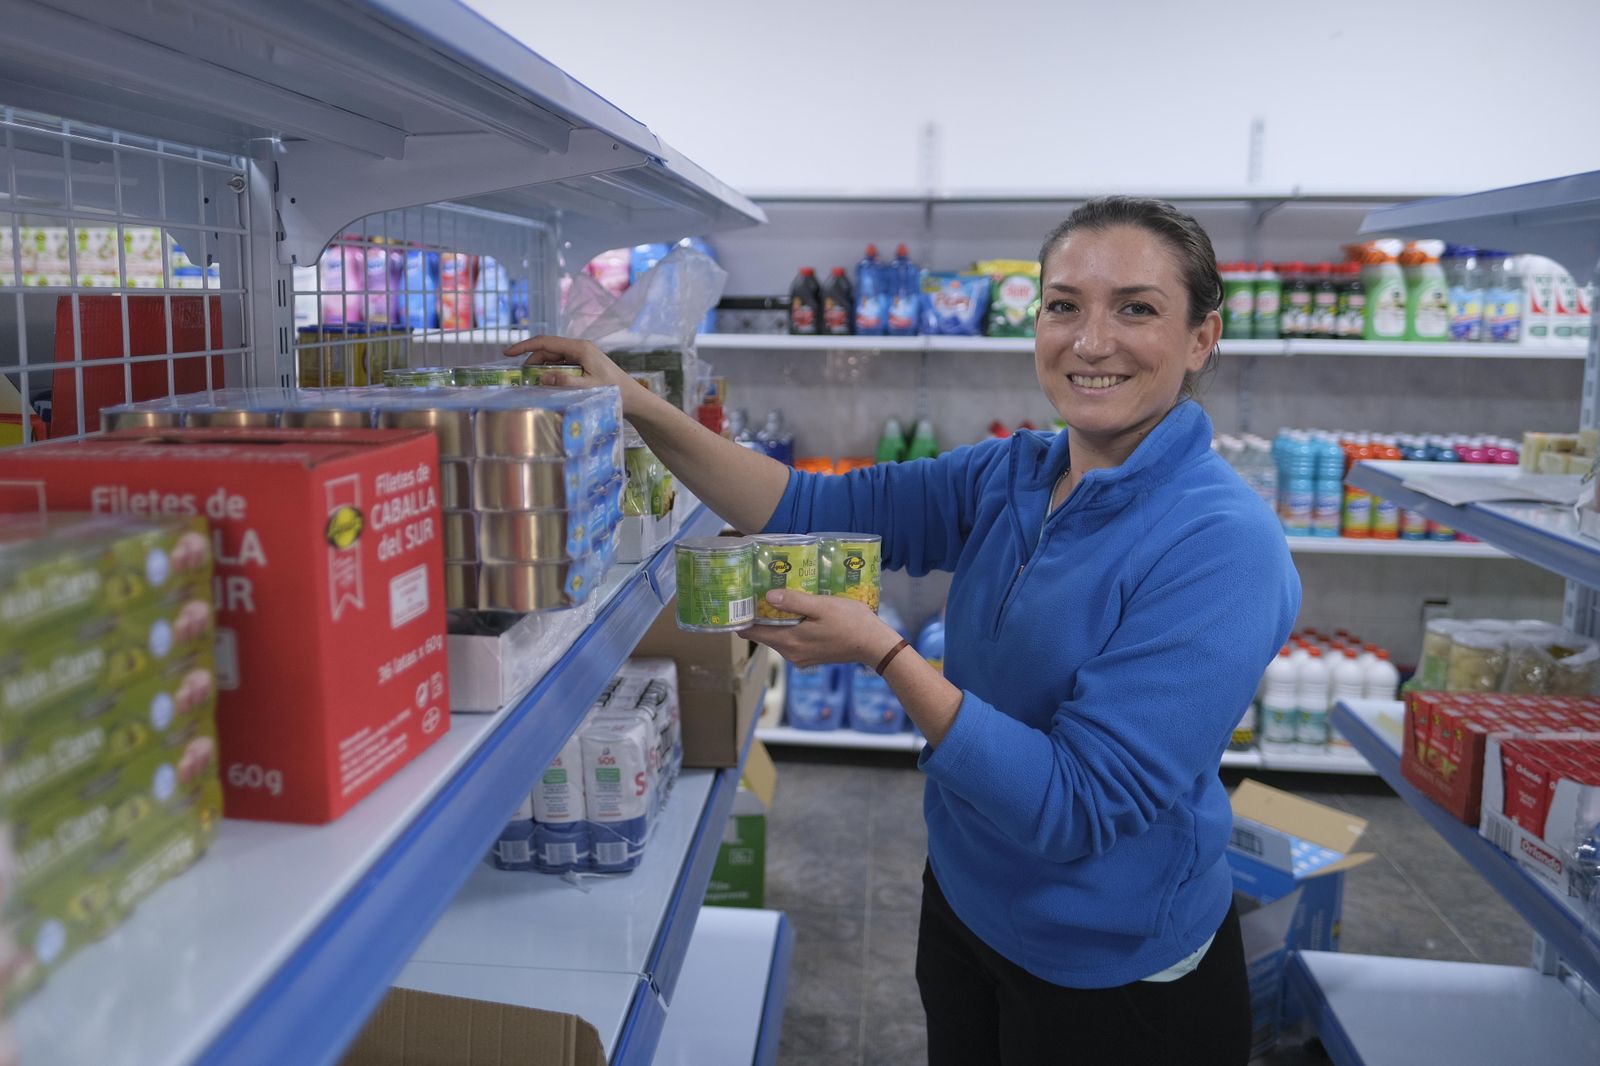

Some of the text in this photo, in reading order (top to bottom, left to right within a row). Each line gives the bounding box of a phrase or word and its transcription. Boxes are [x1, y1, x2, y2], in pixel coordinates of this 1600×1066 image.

[376, 462, 430, 496] Filetes de
[91, 483, 247, 520] Filetes de
[371, 485, 436, 531] CABALLA
[377, 527, 402, 562] del
[405, 516, 434, 550] SUR
[227, 763, 284, 796] 60g
[1521, 840, 1561, 872] Orlando
